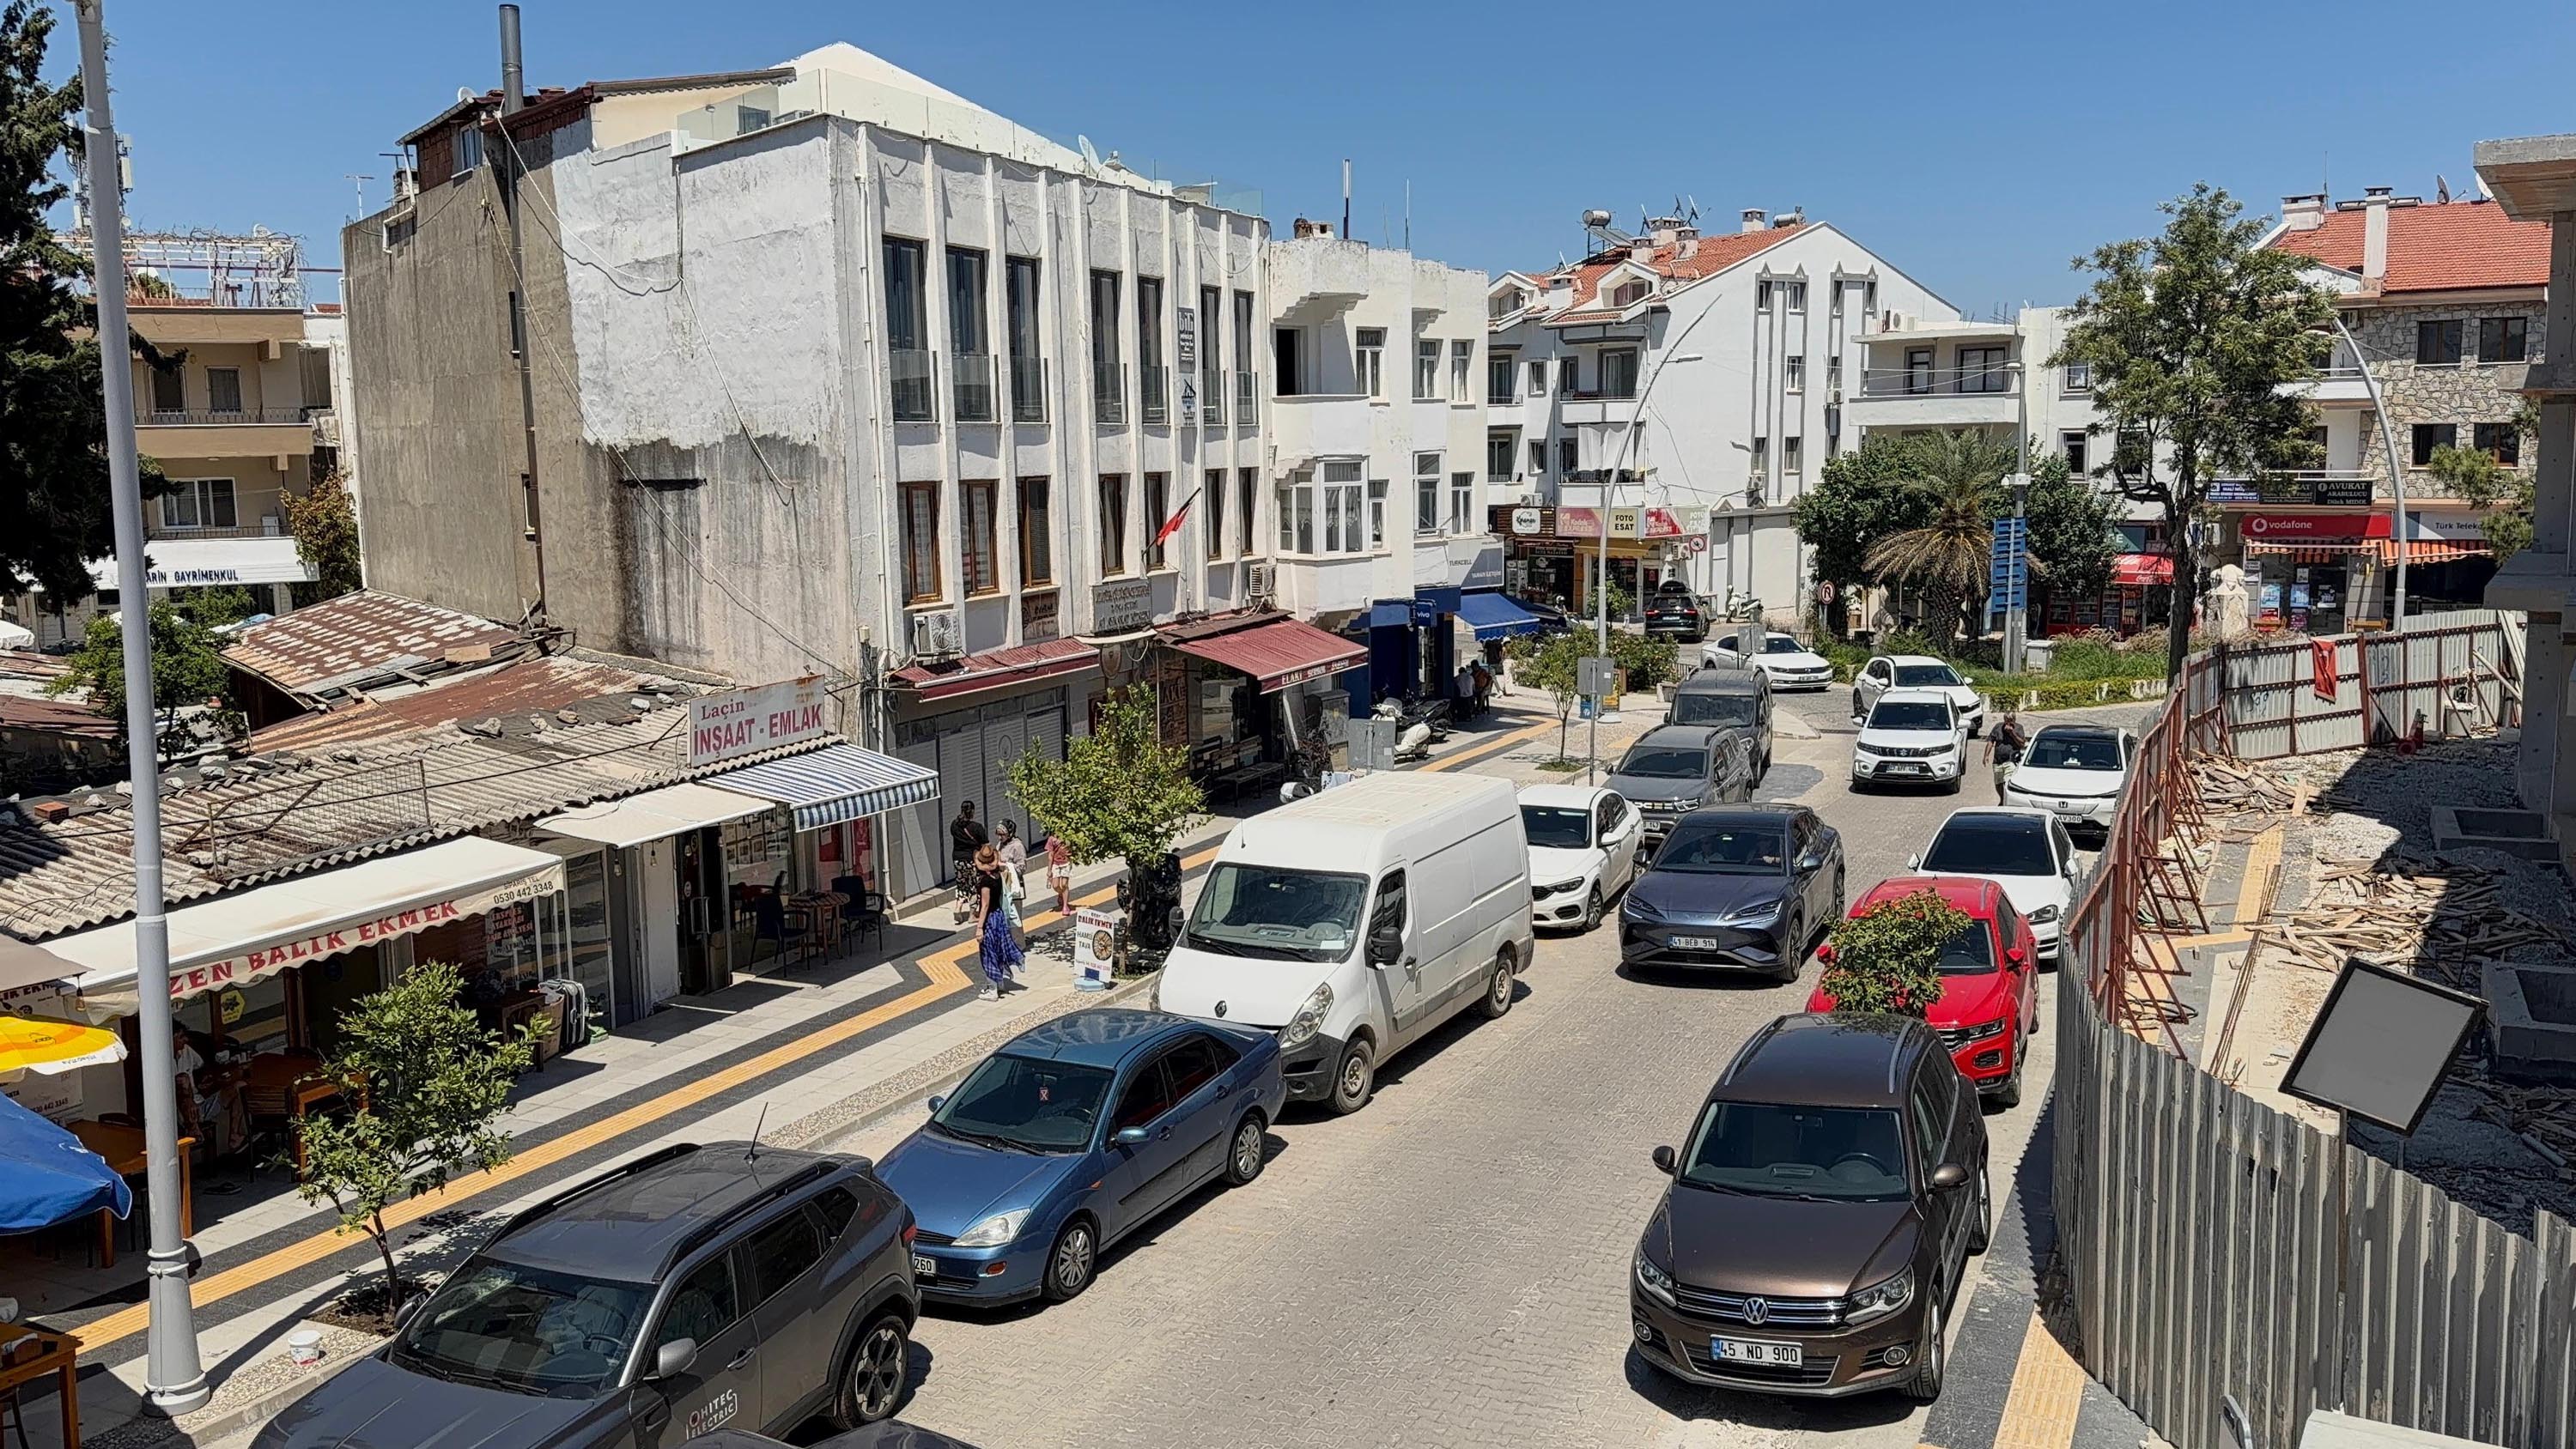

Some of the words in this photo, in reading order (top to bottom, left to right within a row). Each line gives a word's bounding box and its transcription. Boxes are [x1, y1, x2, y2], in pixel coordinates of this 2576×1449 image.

[2269, 519, 2312, 529] vodafone
[146, 570, 167, 584] ARİN
[701, 698, 745, 721] Laçin
[694, 718, 756, 758] İNŞAAT
[769, 703, 823, 739] EMLAK
[494, 890, 515, 905] 0530
[516, 886, 532, 898] 442
[533, 881, 553, 894] 3348
[170, 960, 234, 995] ZEN
[247, 929, 347, 973] BALIK
[357, 900, 460, 943] EKMEK
[1720, 1341, 1735, 1356] 45
[1747, 1344, 1763, 1359] ND
[1773, 1347, 1797, 1362] 900
[691, 1403, 734, 1439] ELECTRIC
